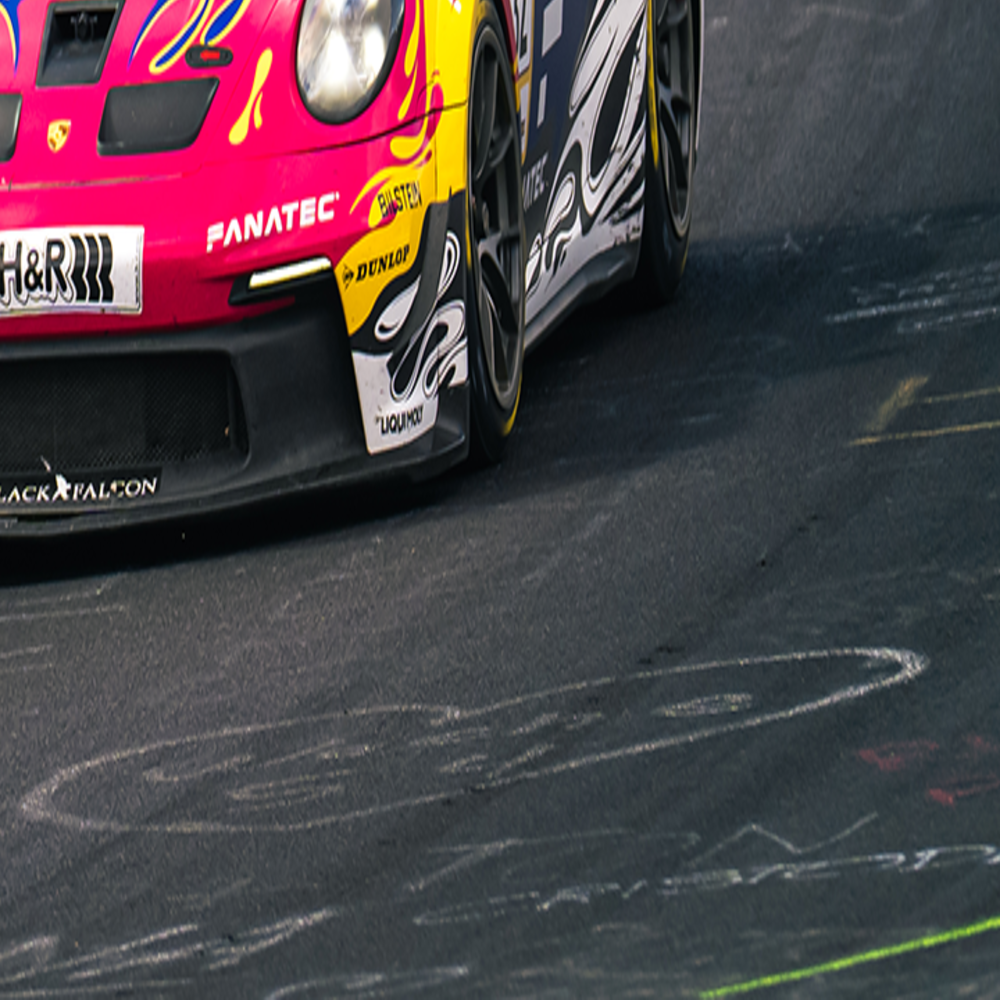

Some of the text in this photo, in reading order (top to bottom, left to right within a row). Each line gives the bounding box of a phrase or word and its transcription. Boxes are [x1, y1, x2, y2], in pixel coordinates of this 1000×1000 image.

[377, 181, 423, 218] BILSTEIN
[206, 191, 336, 254] FANATEC
[355, 244, 410, 283] DUNLOP
[72, 476, 159, 501] FALCON
